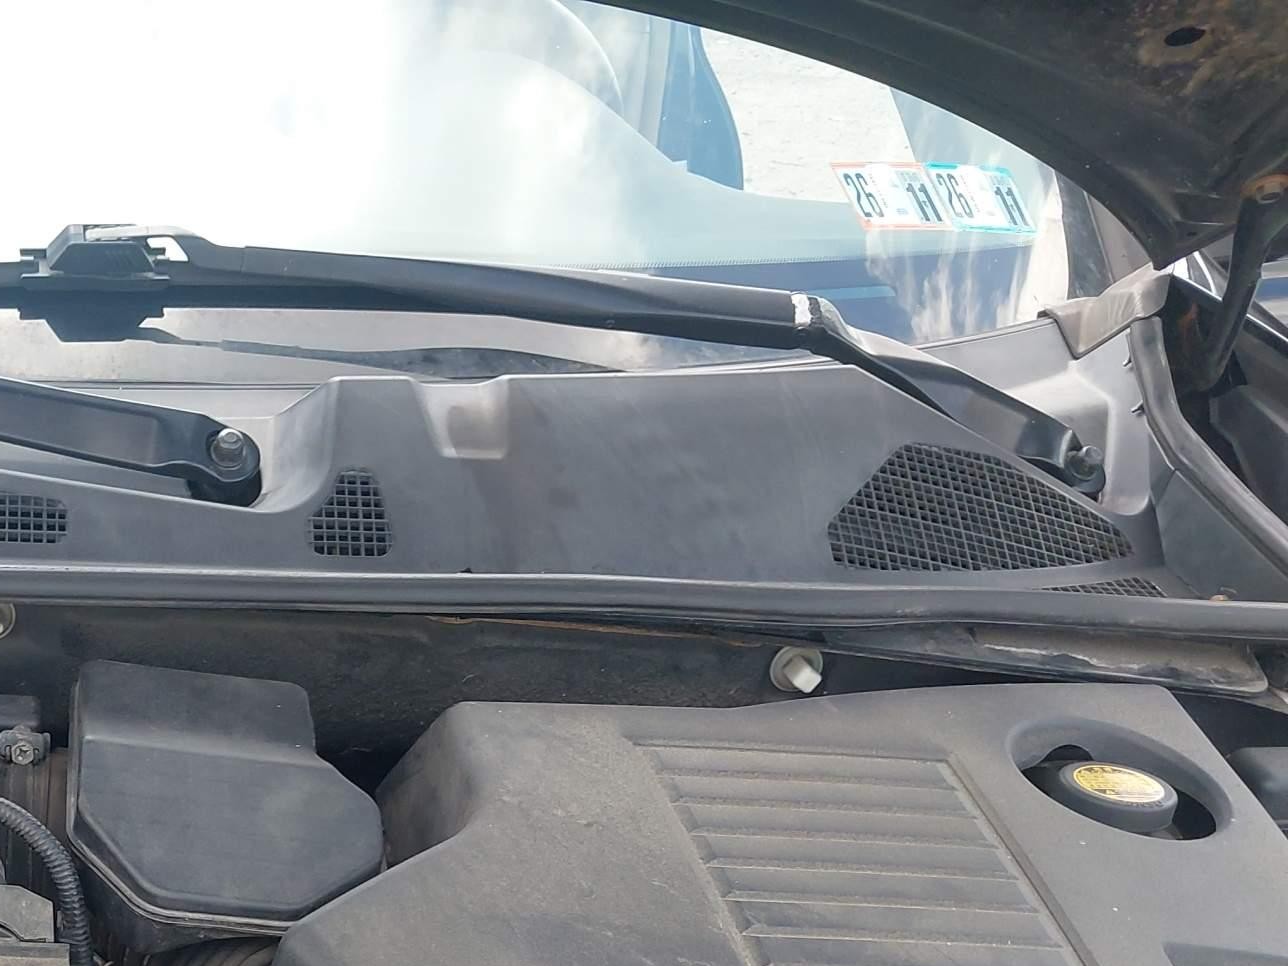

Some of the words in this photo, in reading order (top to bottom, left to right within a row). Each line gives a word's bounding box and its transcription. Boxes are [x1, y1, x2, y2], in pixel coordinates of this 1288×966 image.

[843, 173, 885, 218] 26
[905, 182, 944, 222] 11
[936, 172, 975, 218] 26
[994, 186, 1030, 227] 11
